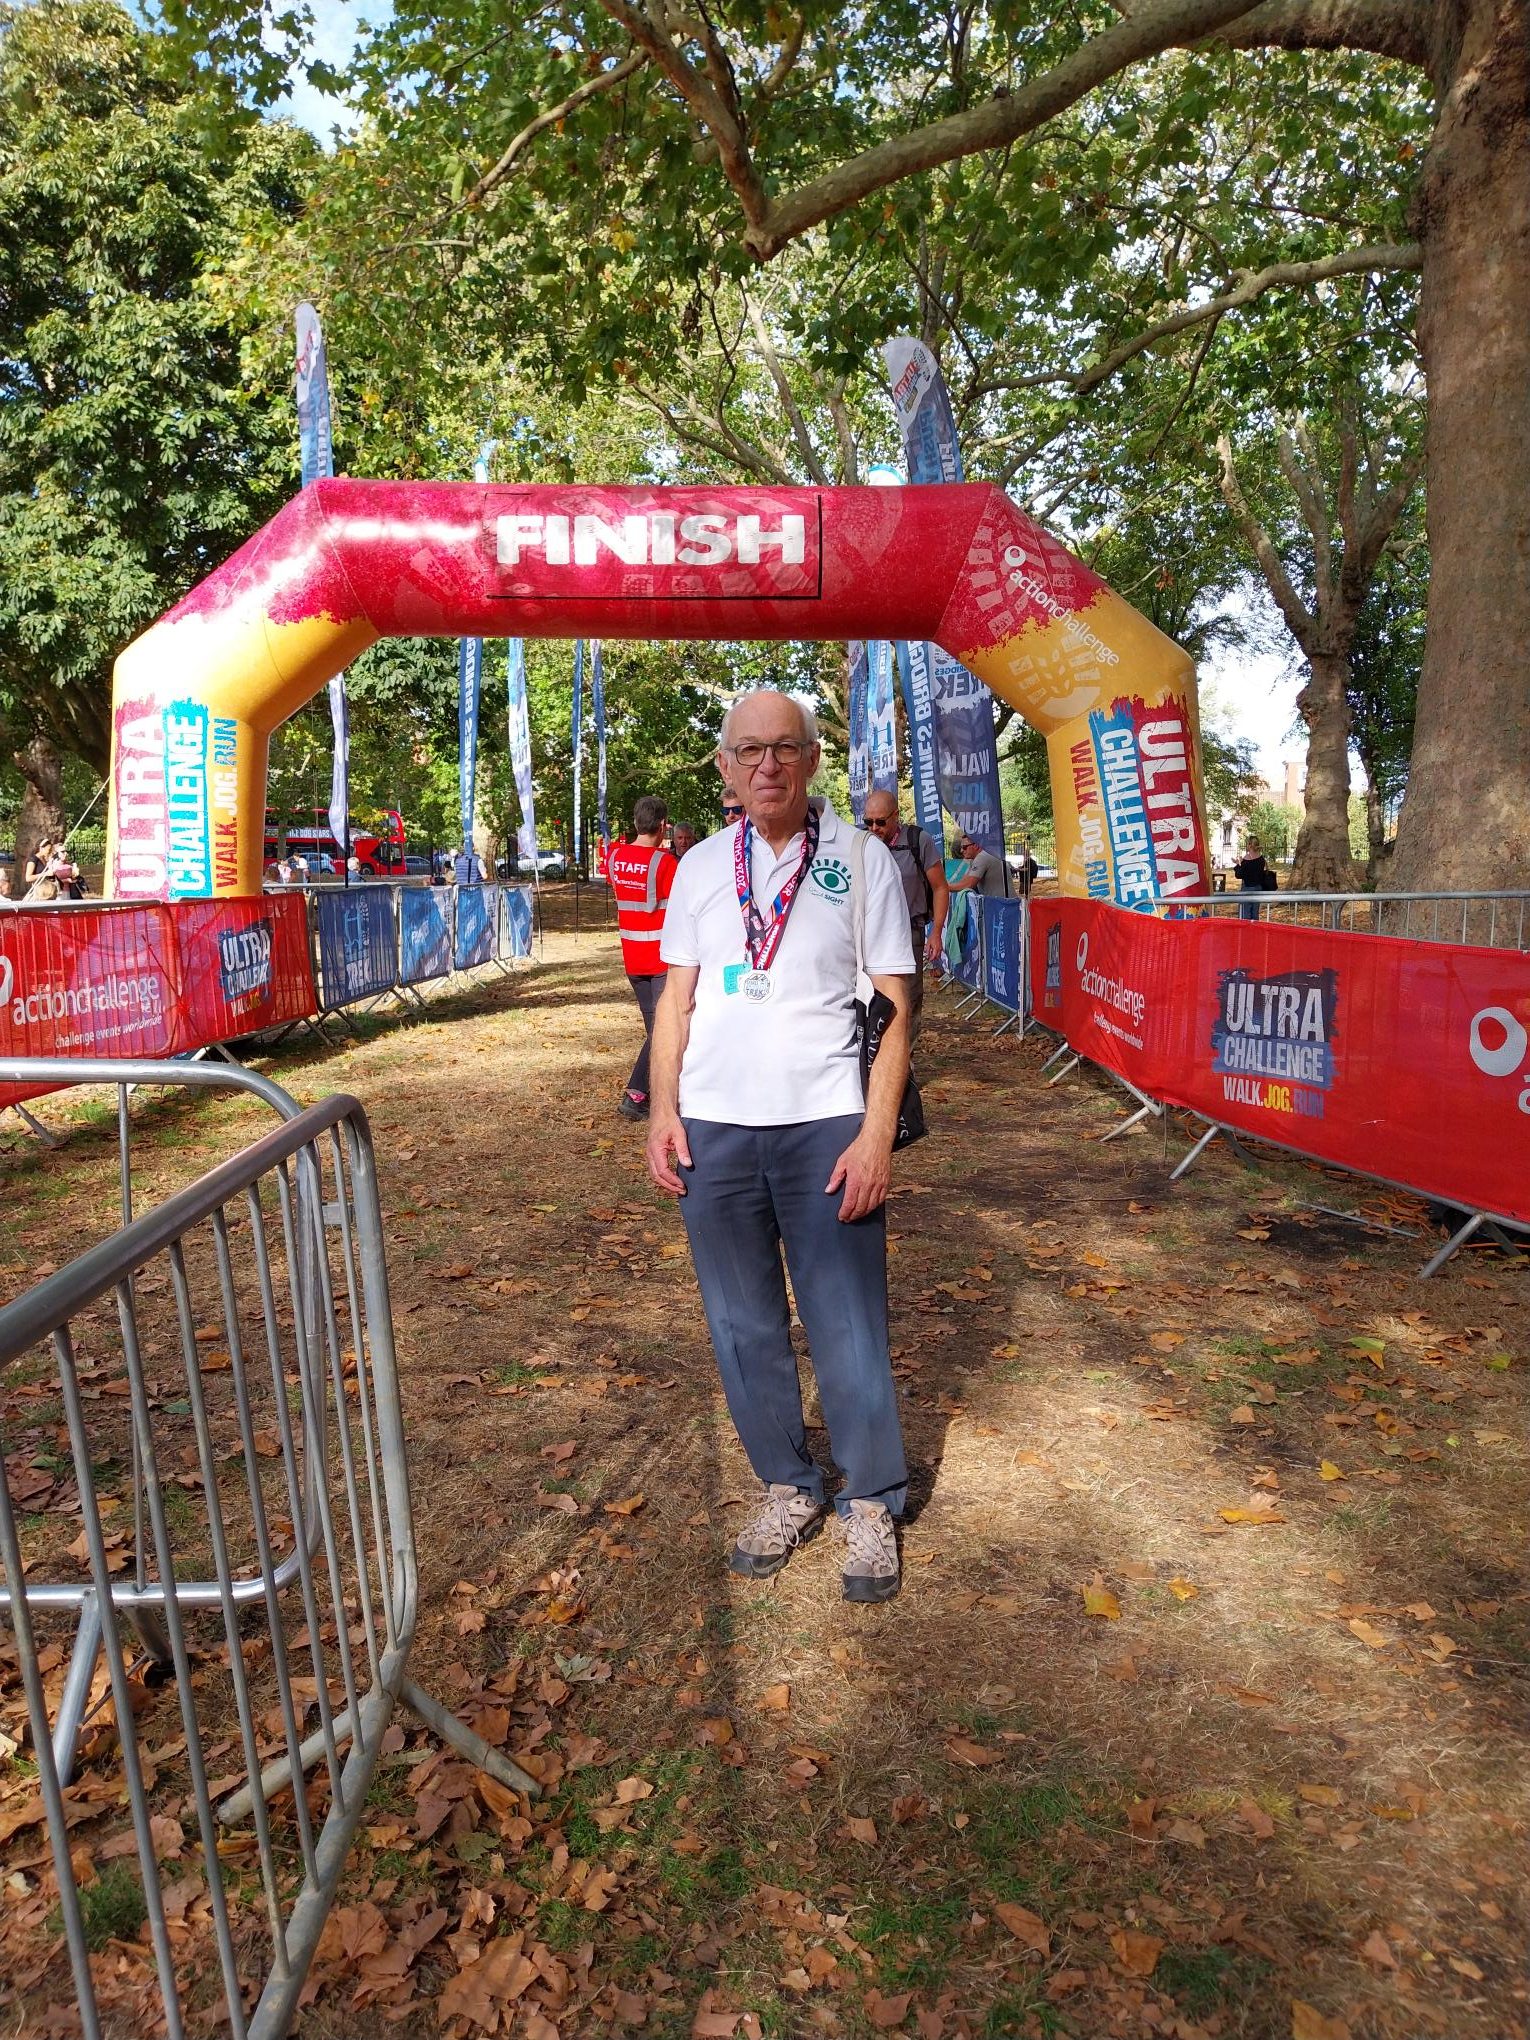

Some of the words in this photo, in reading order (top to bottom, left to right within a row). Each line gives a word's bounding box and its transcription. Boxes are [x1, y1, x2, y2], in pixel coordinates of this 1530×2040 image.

[496, 514, 805, 566] FINISH
[1010, 569, 1119, 666] actionchallenge
[120, 714, 167, 892] ULTRA
[168, 715, 206, 890] CHALLENGE
[1100, 728, 1155, 902] CHALLENGE
[1139, 720, 1200, 897] ULTRA
[614, 861, 648, 874] STAFF
[824, 894, 844, 905] SIGHT
[222, 929, 271, 972] ULTRA
[13, 974, 161, 1026] actionchallenge
[1081, 966, 1145, 1027] actionchallenge
[1226, 983, 1325, 1043] ULTRA
[1224, 1035, 1324, 1083] CHALLENGE
